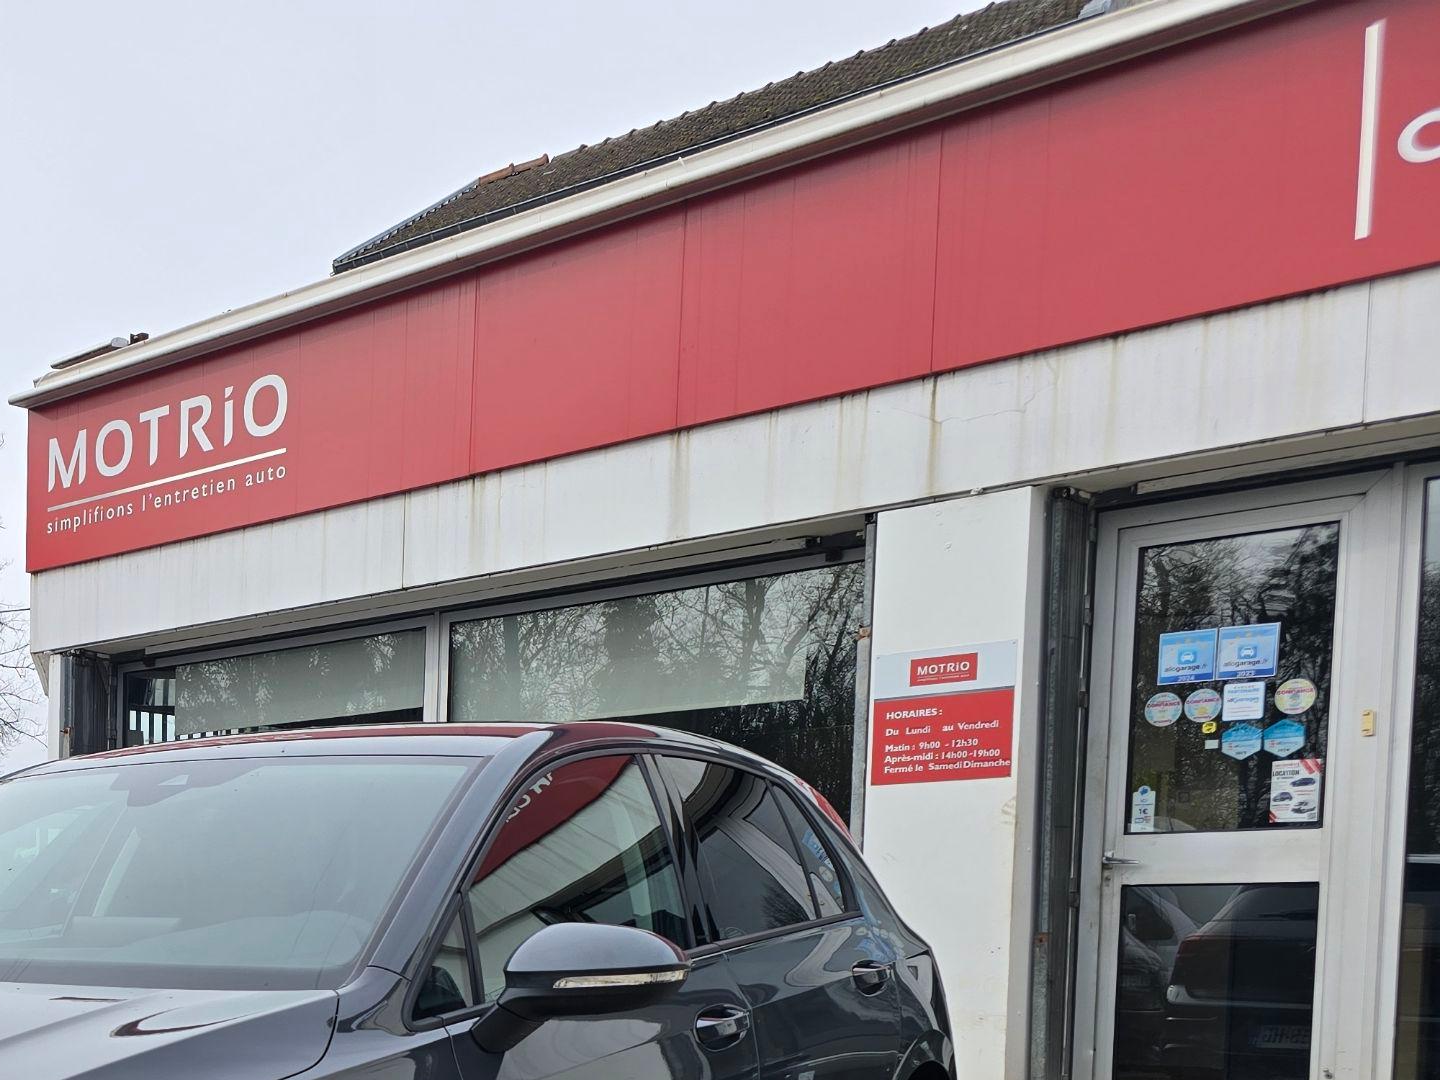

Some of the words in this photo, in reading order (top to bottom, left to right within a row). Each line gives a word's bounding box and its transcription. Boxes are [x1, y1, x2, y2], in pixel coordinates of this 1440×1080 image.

[47, 501, 133, 534] simplifions
[142, 476, 236, 511] l'entretien
[245, 464, 286, 487] auto
[885, 728, 899, 737] Du
[905, 725, 931, 735] Lundi
[942, 724, 954, 732] au
[957, 719, 1000, 731] Vendredi
[919, 741, 941, 750] 9h00
[951, 738, 979, 748] 12h30
[884, 764, 914, 774] Fermé
[915, 763, 924, 772] le
[928, 760, 963, 771] Samedi
[963, 758, 1011, 769] Dimanche
